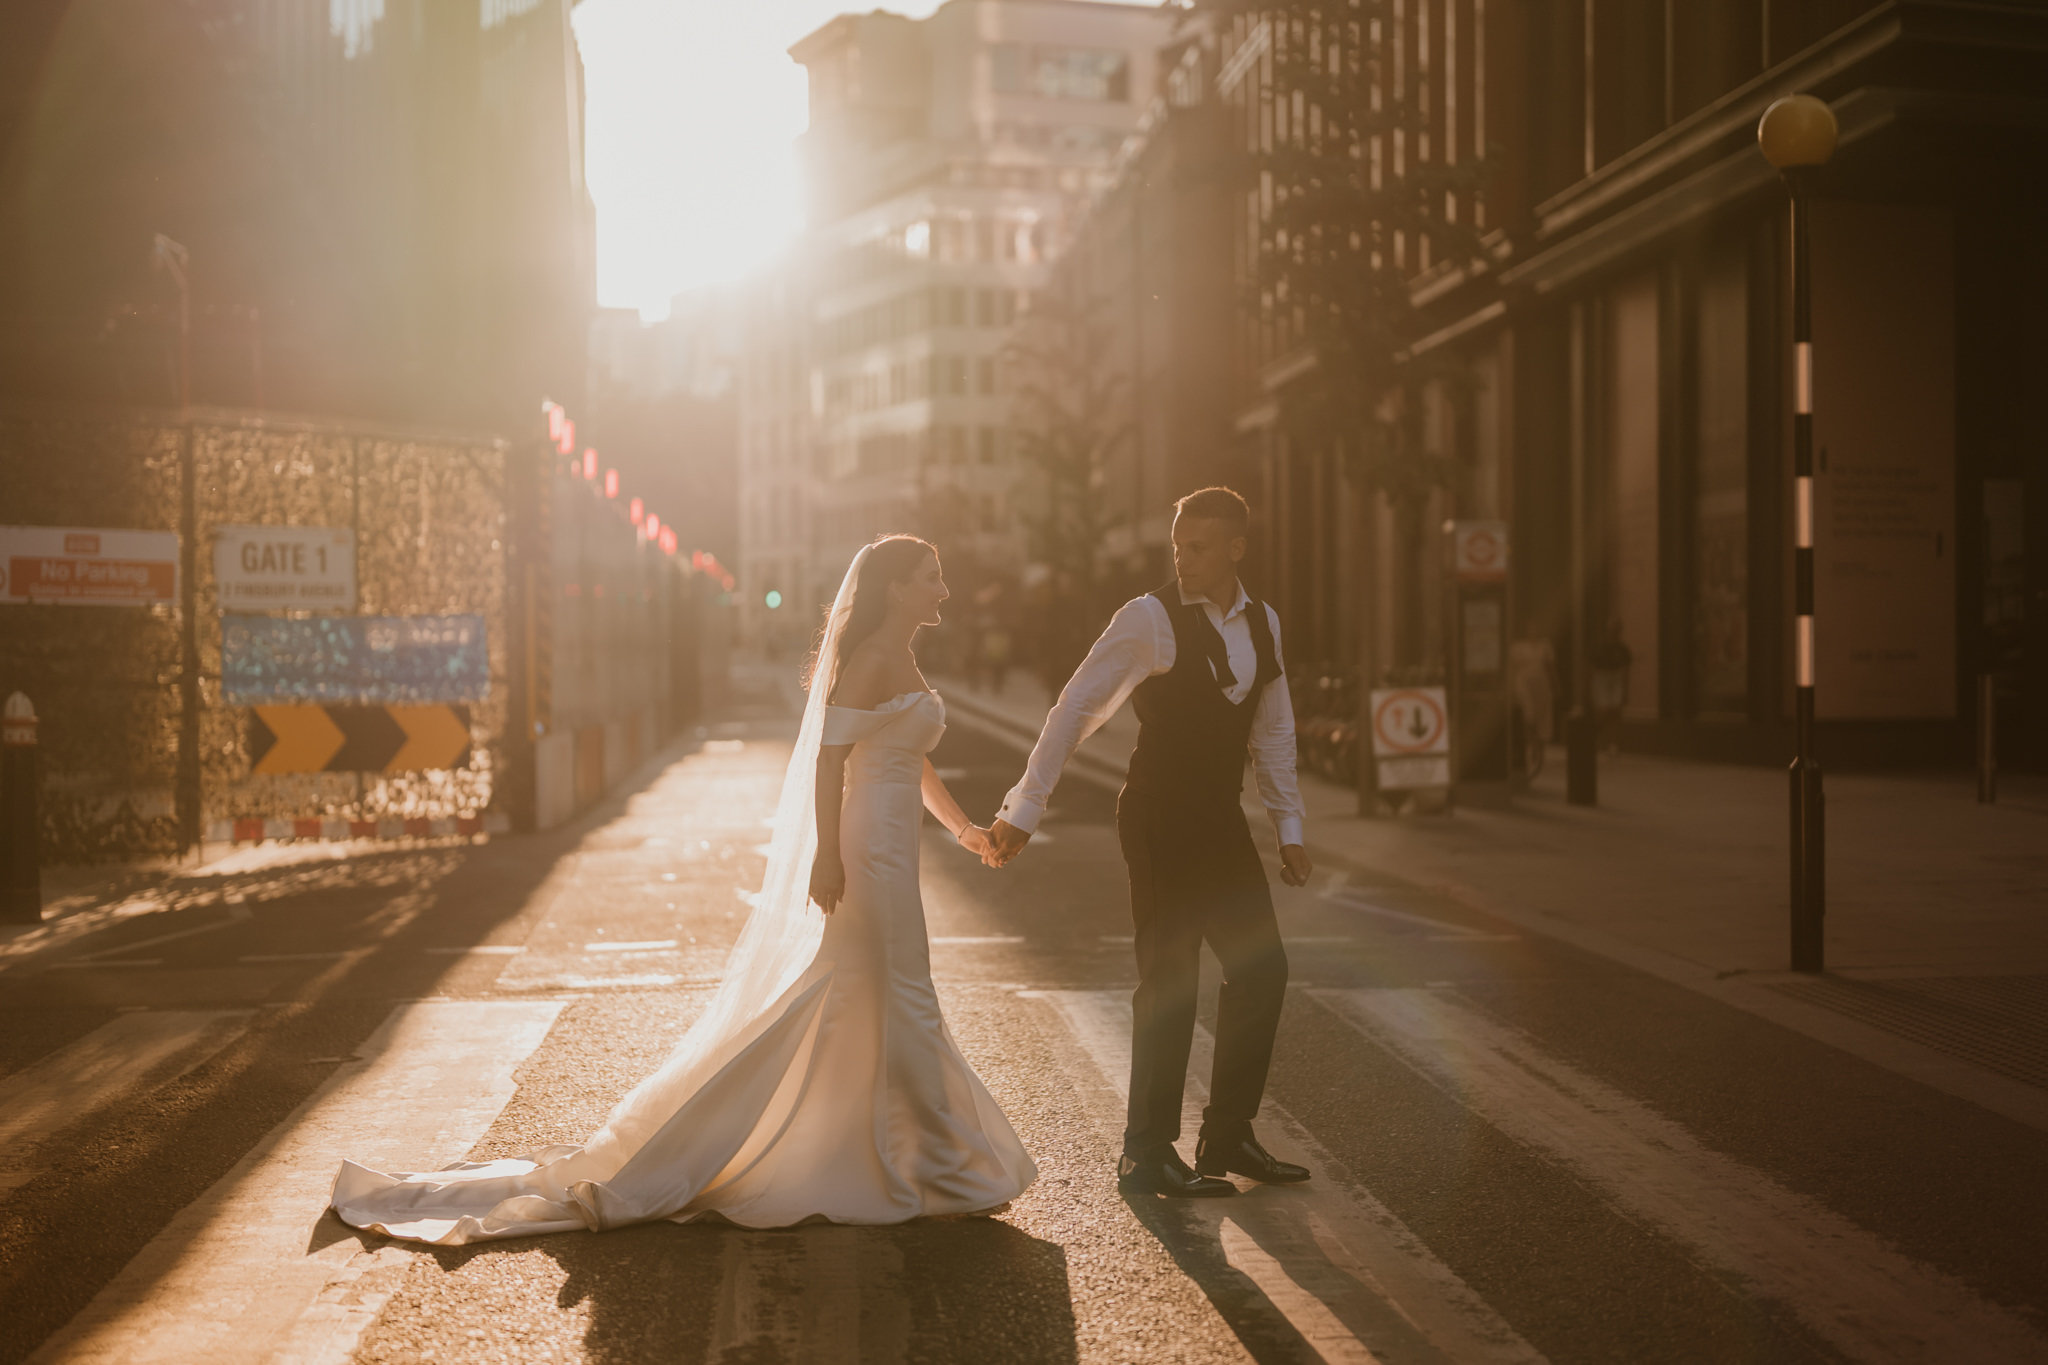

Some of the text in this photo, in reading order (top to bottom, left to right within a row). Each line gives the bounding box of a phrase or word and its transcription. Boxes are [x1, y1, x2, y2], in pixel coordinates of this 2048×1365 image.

[40, 559, 149, 585] No Parking
[241, 541, 327, 575] GATE 1
